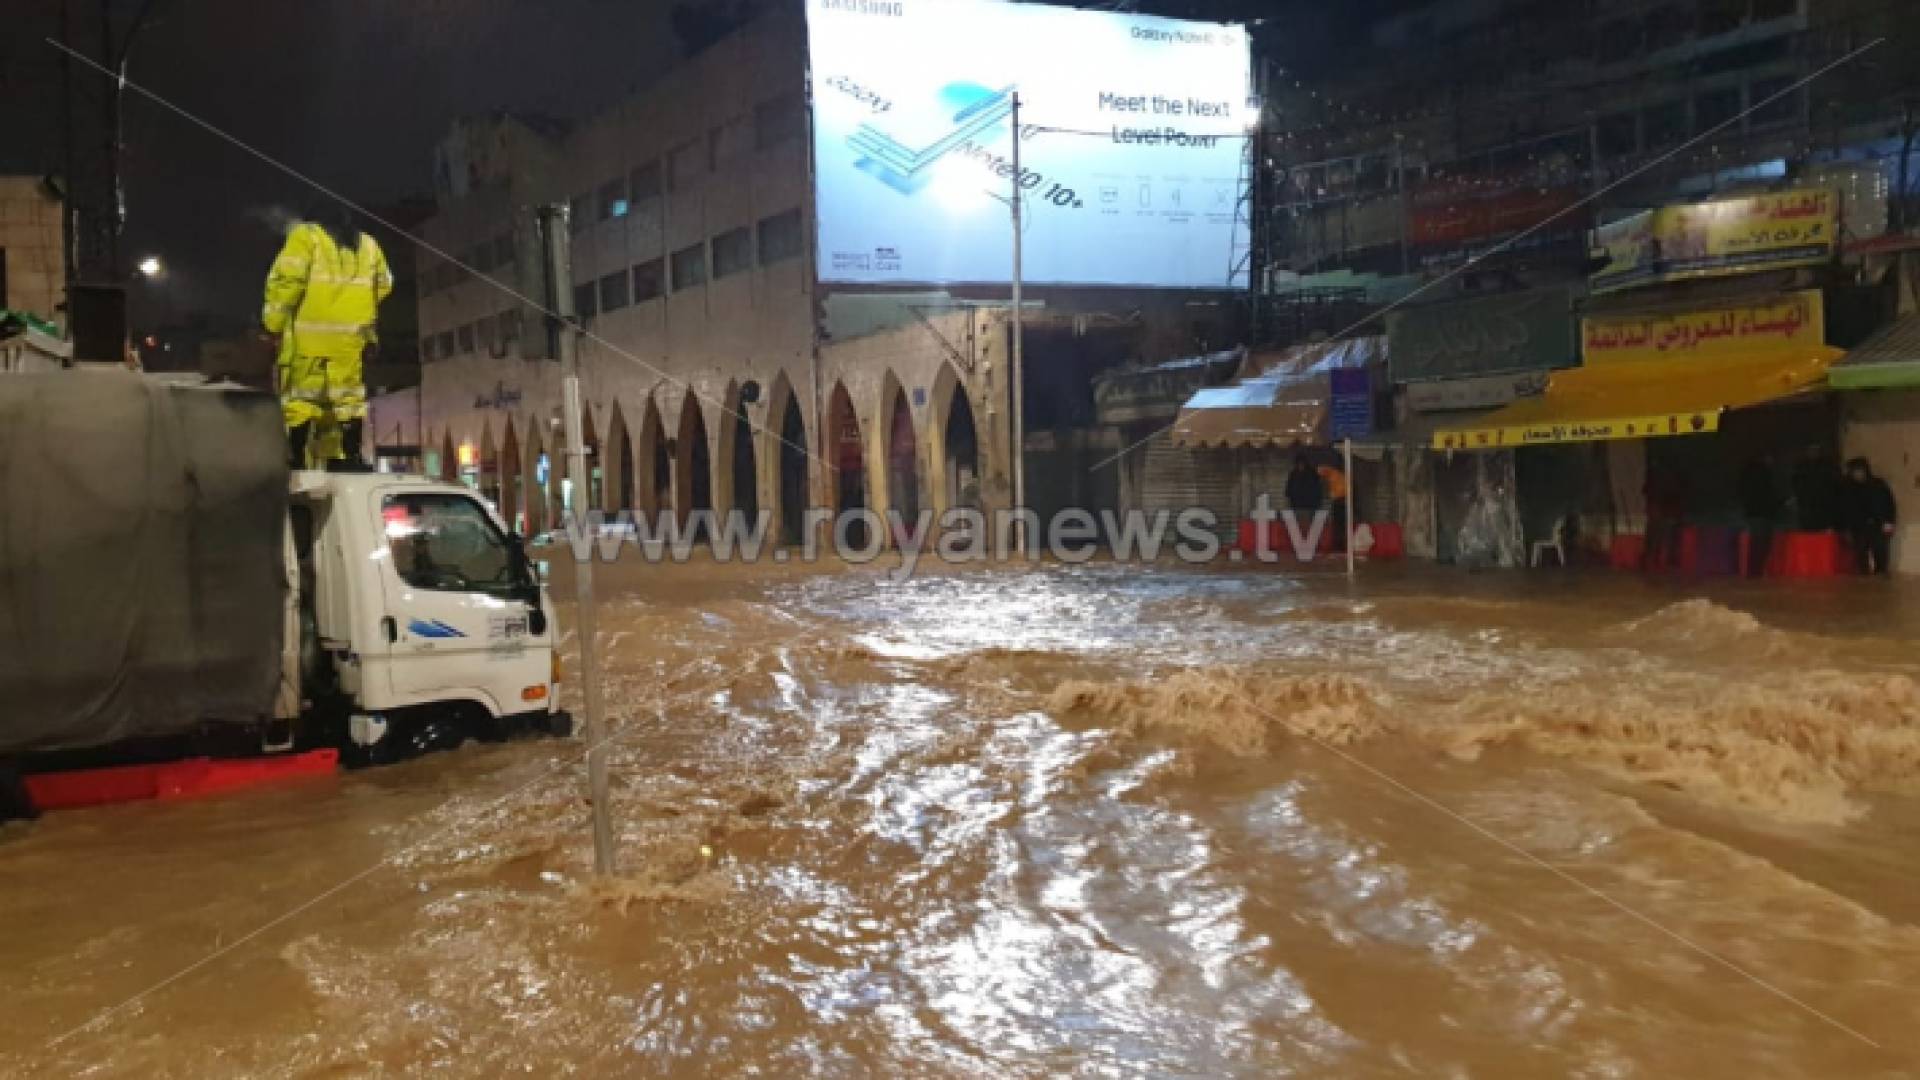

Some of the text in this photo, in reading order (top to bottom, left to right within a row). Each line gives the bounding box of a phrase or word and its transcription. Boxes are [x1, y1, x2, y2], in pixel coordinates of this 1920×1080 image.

[1098, 90, 1230, 117] Meet the Next
[1111, 123, 1217, 149] Level Power
